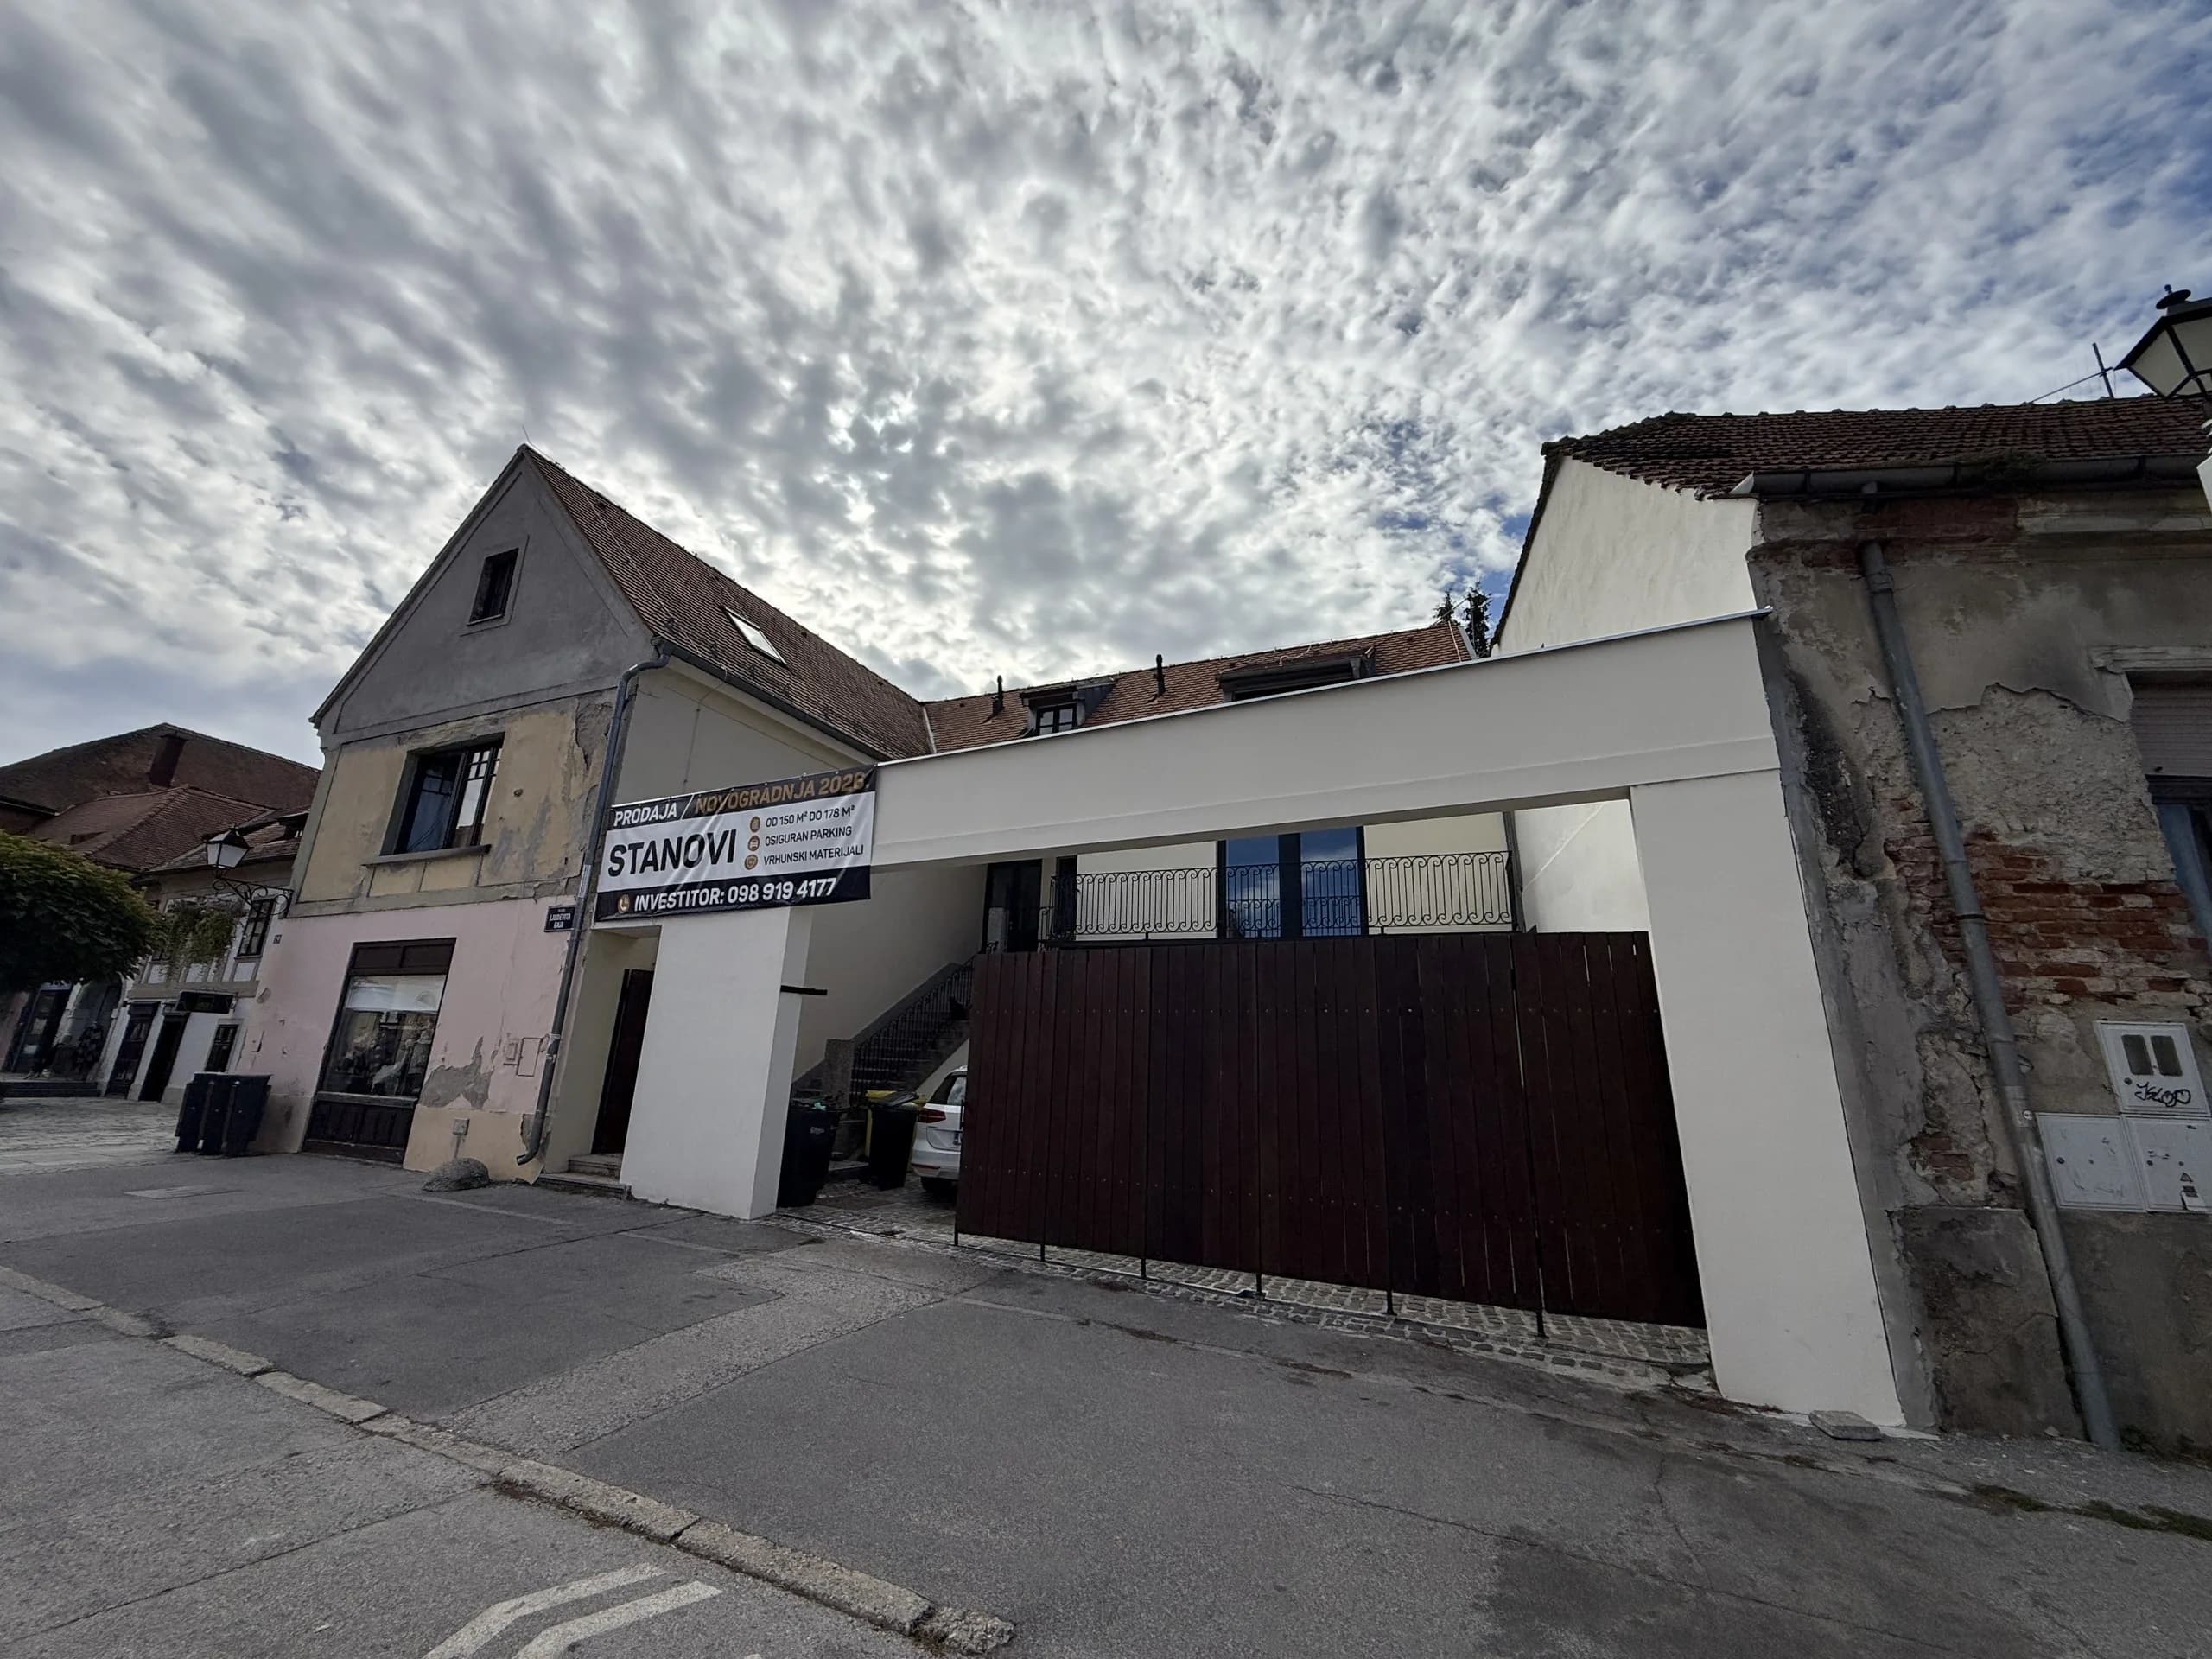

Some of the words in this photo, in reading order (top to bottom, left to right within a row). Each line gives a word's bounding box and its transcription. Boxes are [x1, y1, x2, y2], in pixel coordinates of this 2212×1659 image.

[613, 803, 677, 827] PRODAJA
[695, 779, 815, 814] NOVOGRADNJA
[766, 817, 778, 828] OD
[779, 814, 795, 826] 150
[809, 810, 823, 822] DO
[824, 807, 840, 819] 178
[765, 830, 809, 847] OSIGURAN
[810, 825, 852, 838] PARKING
[607, 829, 737, 877] STANOVI
[763, 852, 808, 866] VRHUNSKI
[809, 844, 864, 861] MATERIJALI
[634, 887, 724, 912] INVESTITOR:
[728, 883, 759, 903] 098
[762, 880, 794, 901] 919
[796, 877, 837, 899] 4177
